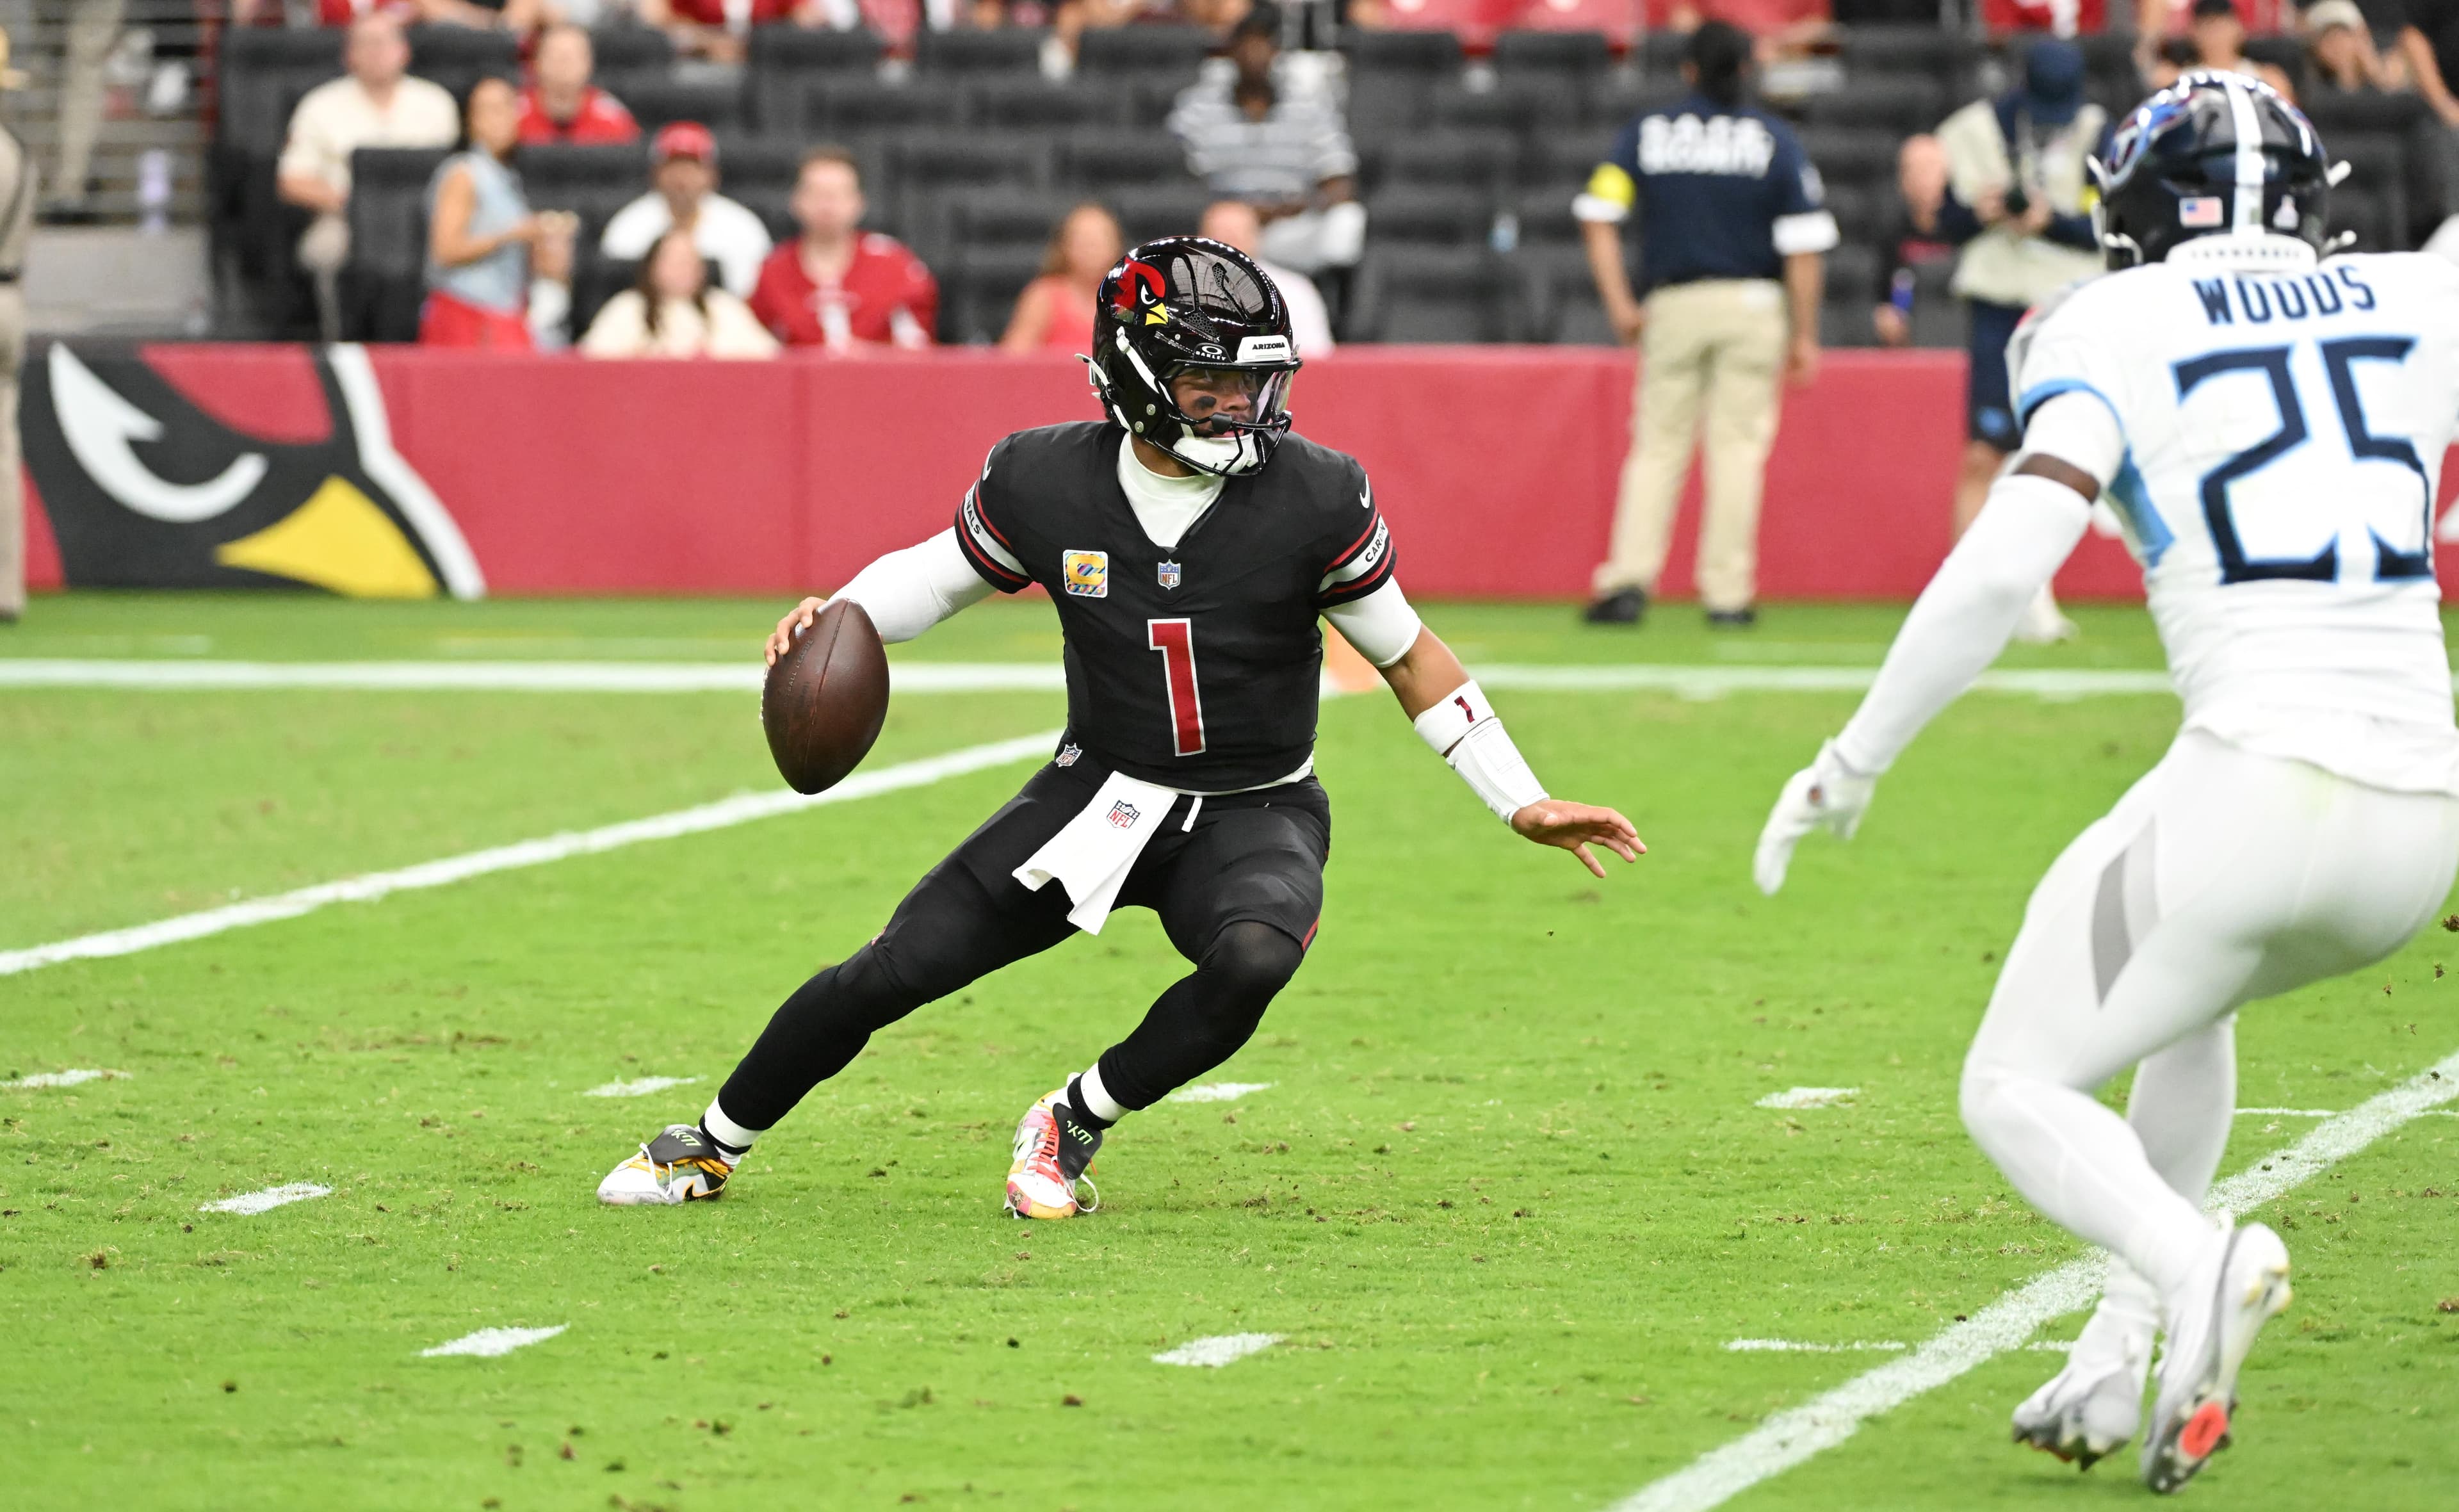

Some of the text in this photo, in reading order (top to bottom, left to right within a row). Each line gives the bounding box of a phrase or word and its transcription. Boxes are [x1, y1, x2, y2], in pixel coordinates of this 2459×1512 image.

[2191, 264, 2376, 325] WOODS
[1196, 350, 1226, 361] OAKLEY
[1252, 342, 1285, 350] ARIZONA
[2170, 336, 2433, 585] 25
[1161, 574, 1177, 585] NFL
[1148, 617, 1206, 757] 1
[1454, 695, 1475, 724] 1
[1108, 809, 1131, 829] NFL
